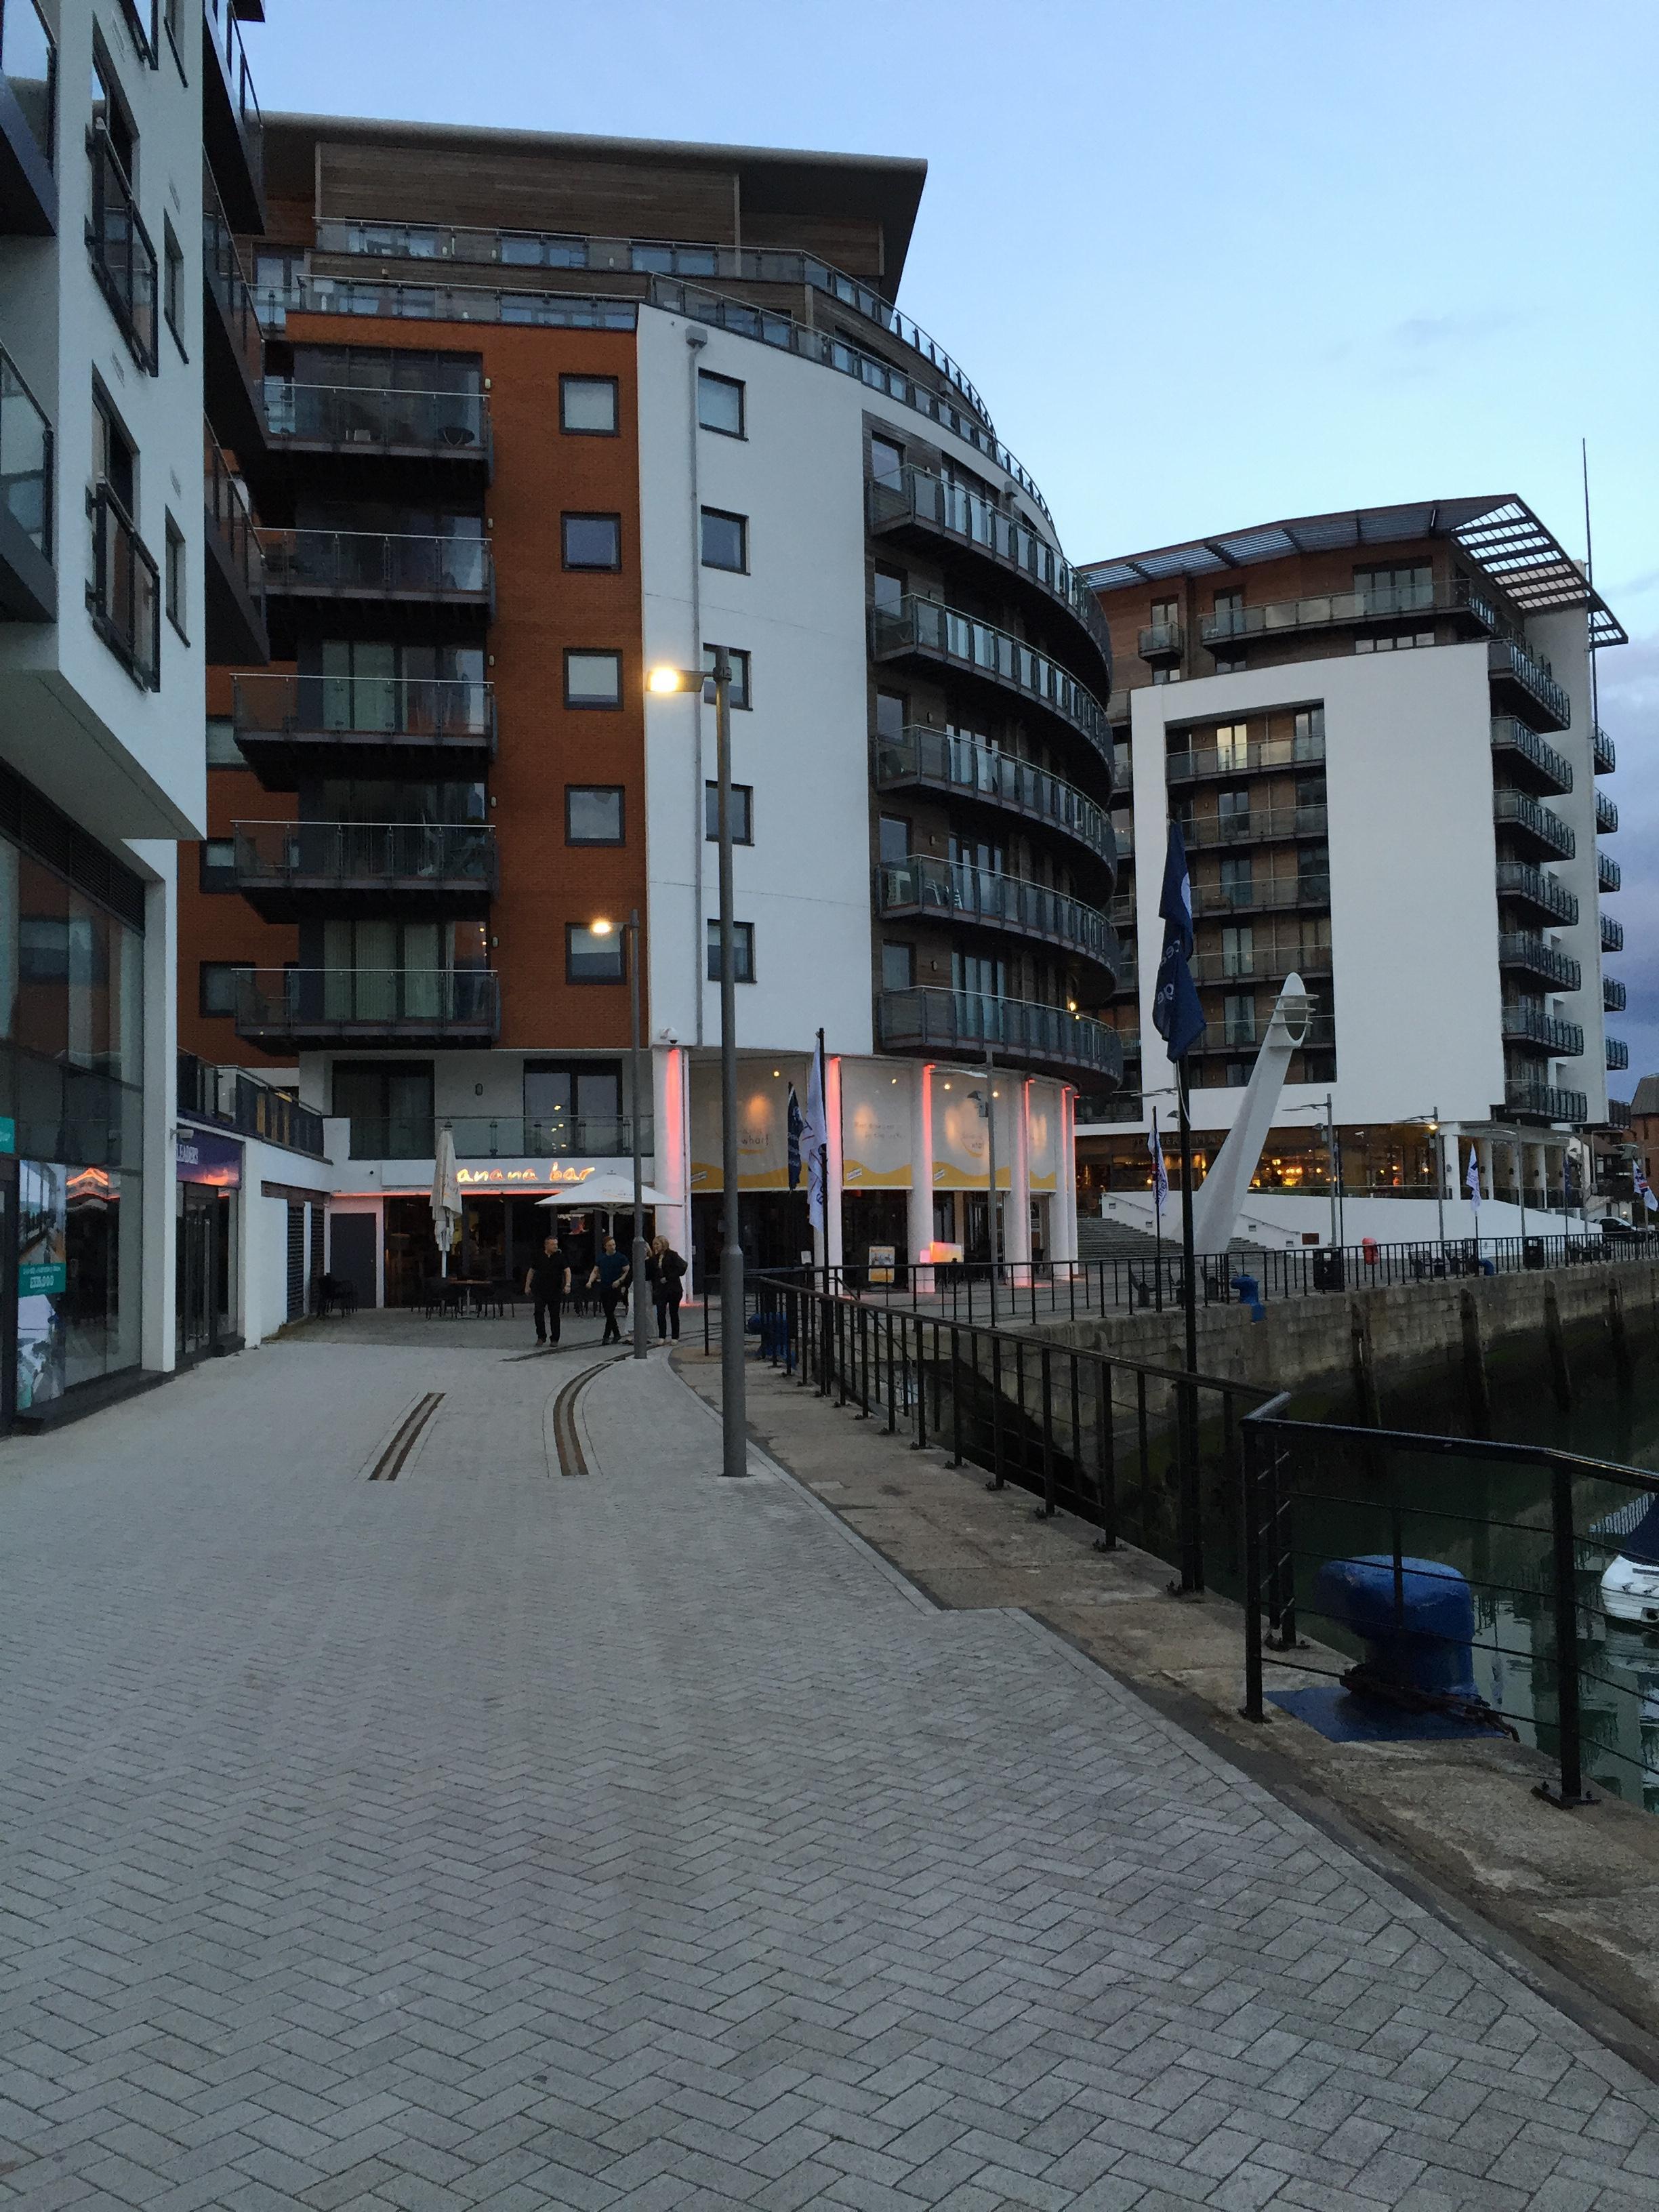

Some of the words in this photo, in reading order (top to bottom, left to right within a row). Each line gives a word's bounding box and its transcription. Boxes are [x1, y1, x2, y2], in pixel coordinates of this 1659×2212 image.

[742, 1134, 769, 1146] wharf
[456, 1168, 539, 1183] anana
[549, 1162, 596, 1181] bar
